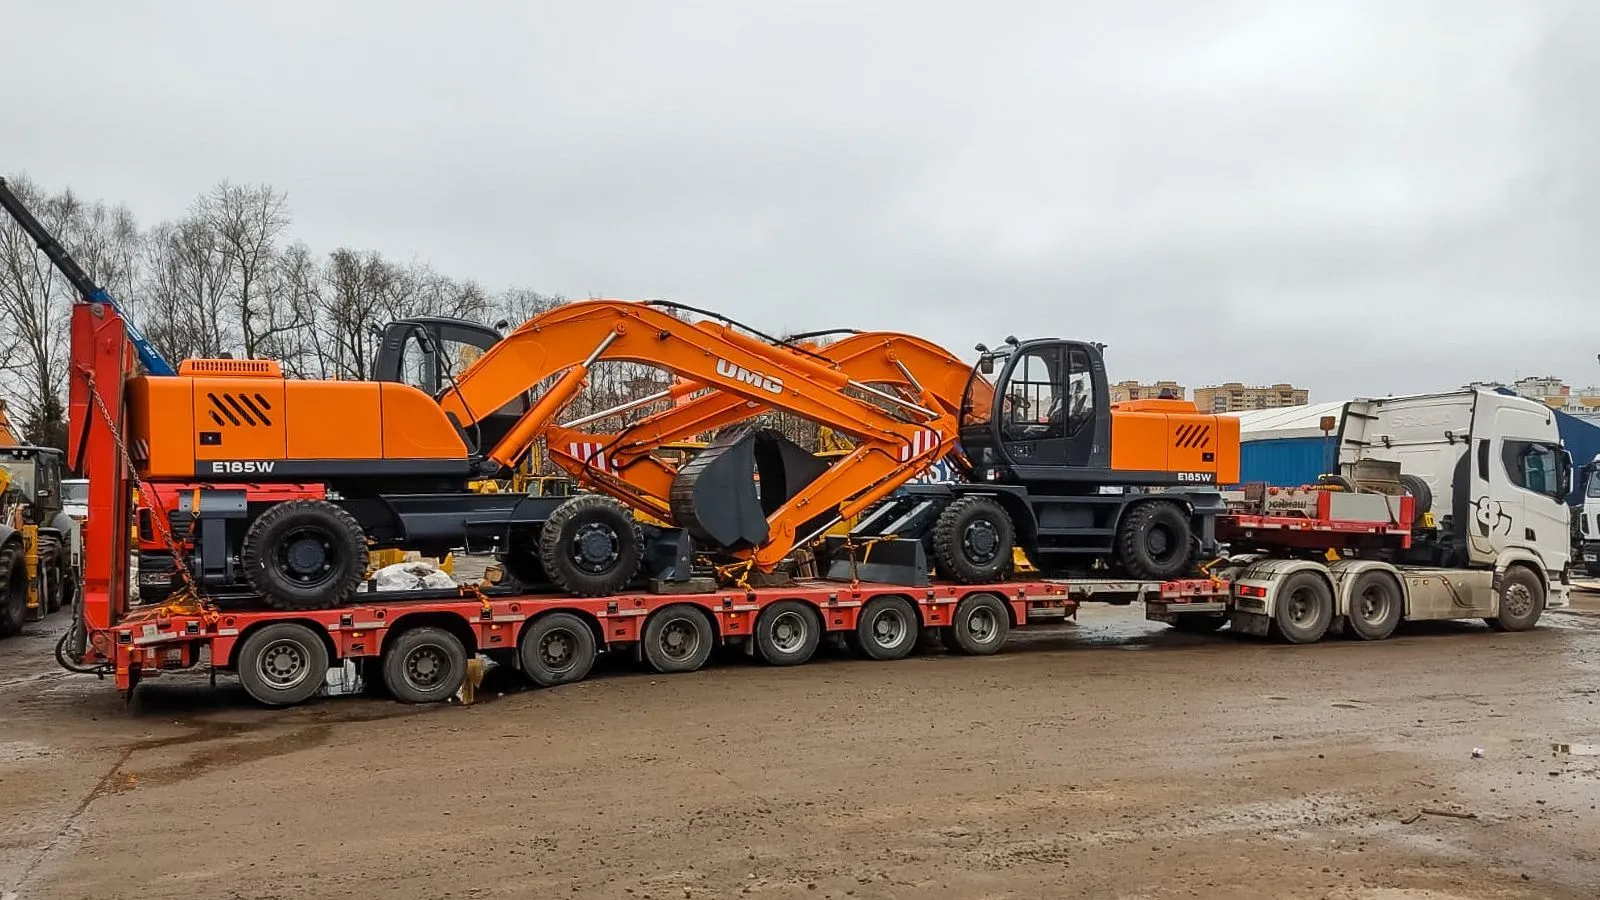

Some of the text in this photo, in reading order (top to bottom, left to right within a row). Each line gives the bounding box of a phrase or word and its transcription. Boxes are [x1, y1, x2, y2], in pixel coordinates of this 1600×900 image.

[716, 358, 783, 394] UMG
[212, 461, 275, 473] E185W
[1177, 472, 1212, 482] E185W
